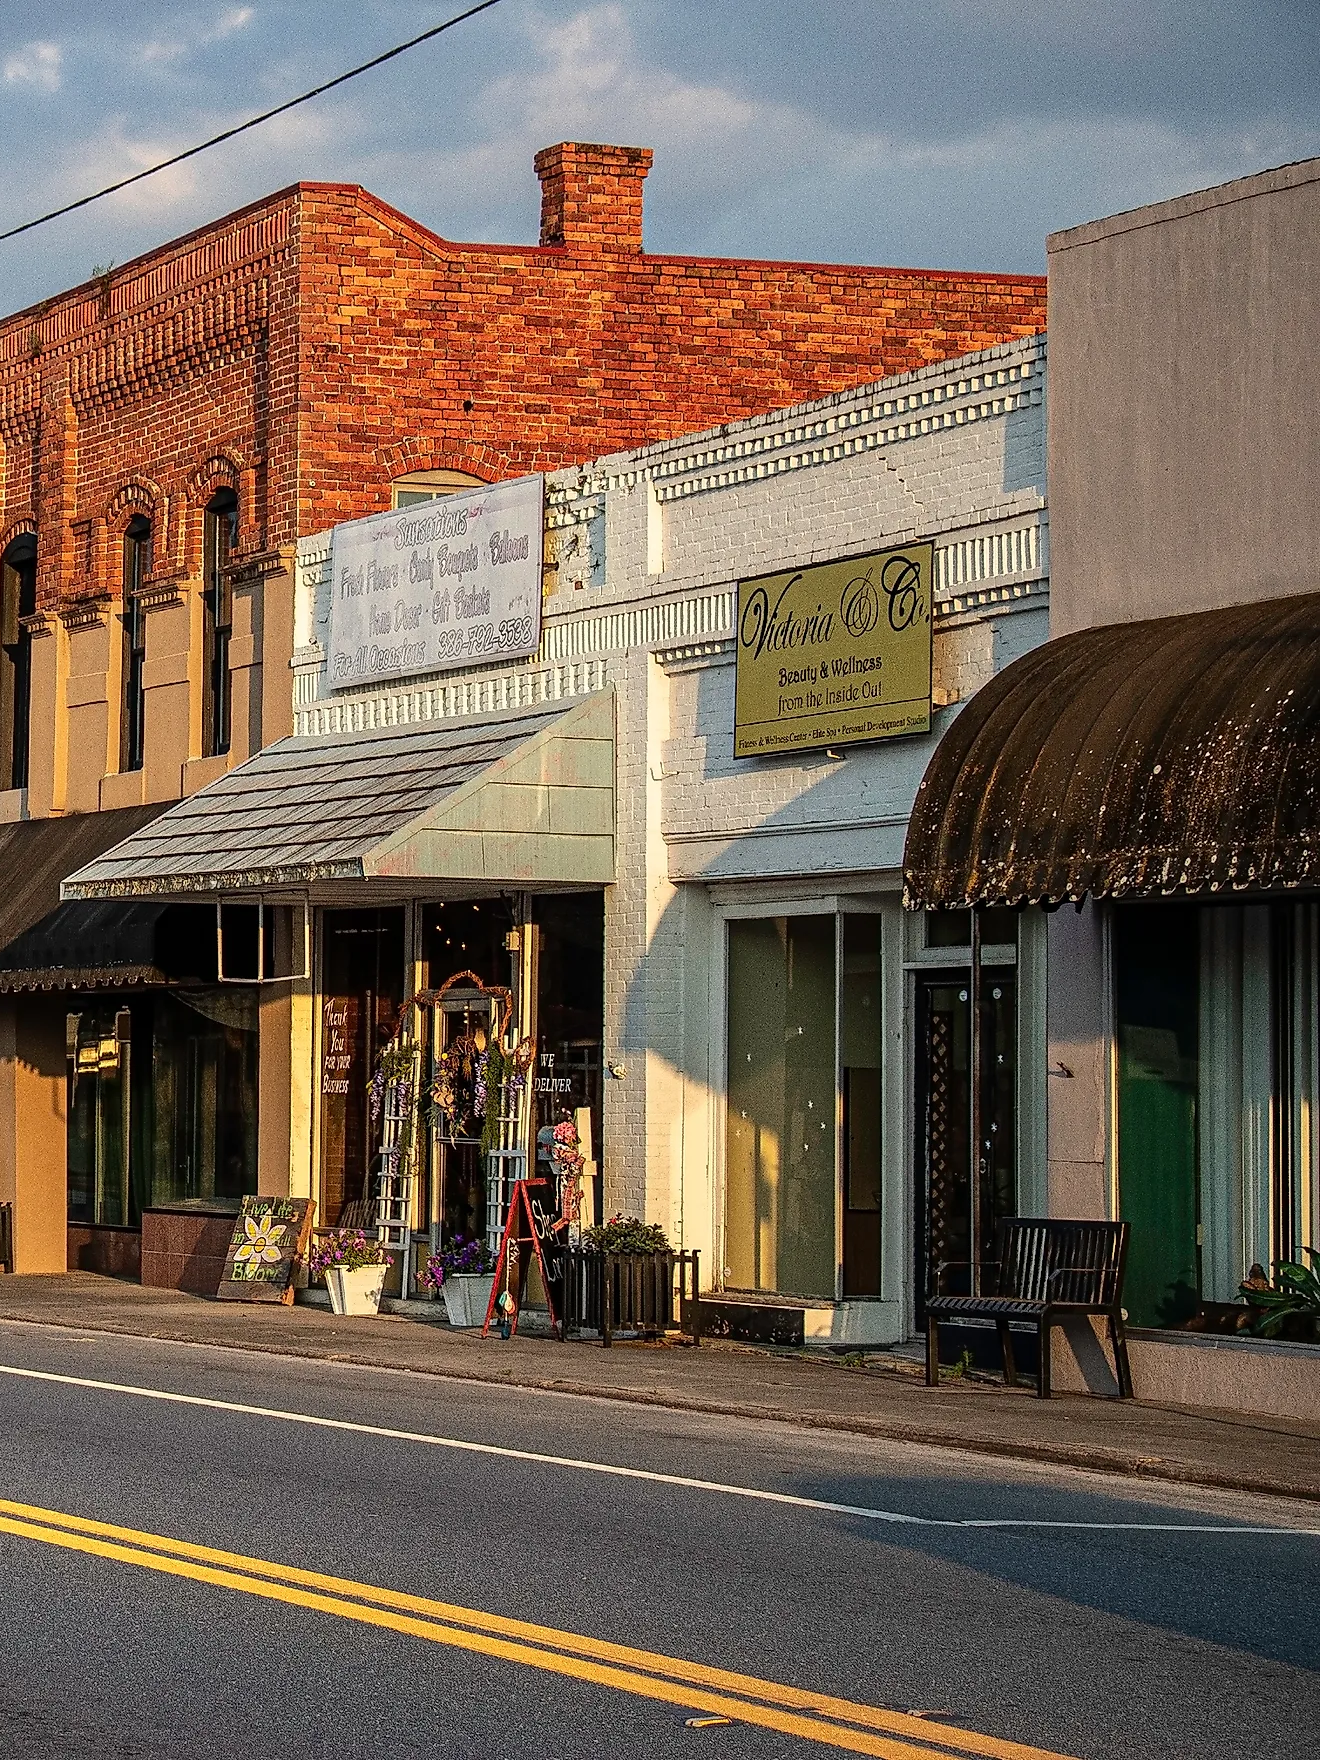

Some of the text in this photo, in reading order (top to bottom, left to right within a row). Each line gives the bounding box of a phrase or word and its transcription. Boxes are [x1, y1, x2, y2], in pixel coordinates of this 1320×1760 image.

[394, 505, 468, 550] Sunsations
[741, 574, 836, 660] Victoria
[881, 555, 930, 631] Co.
[438, 616, 534, 660] 386-792-3538
[333, 638, 427, 680] For All Occasions
[778, 655, 883, 688] Beauty & Wellness
[778, 680, 883, 716] from the Inside Out
[324, 997, 349, 1027] Thank
[540, 1053, 555, 1068] WE
[534, 1077, 572, 1093] DELIVER
